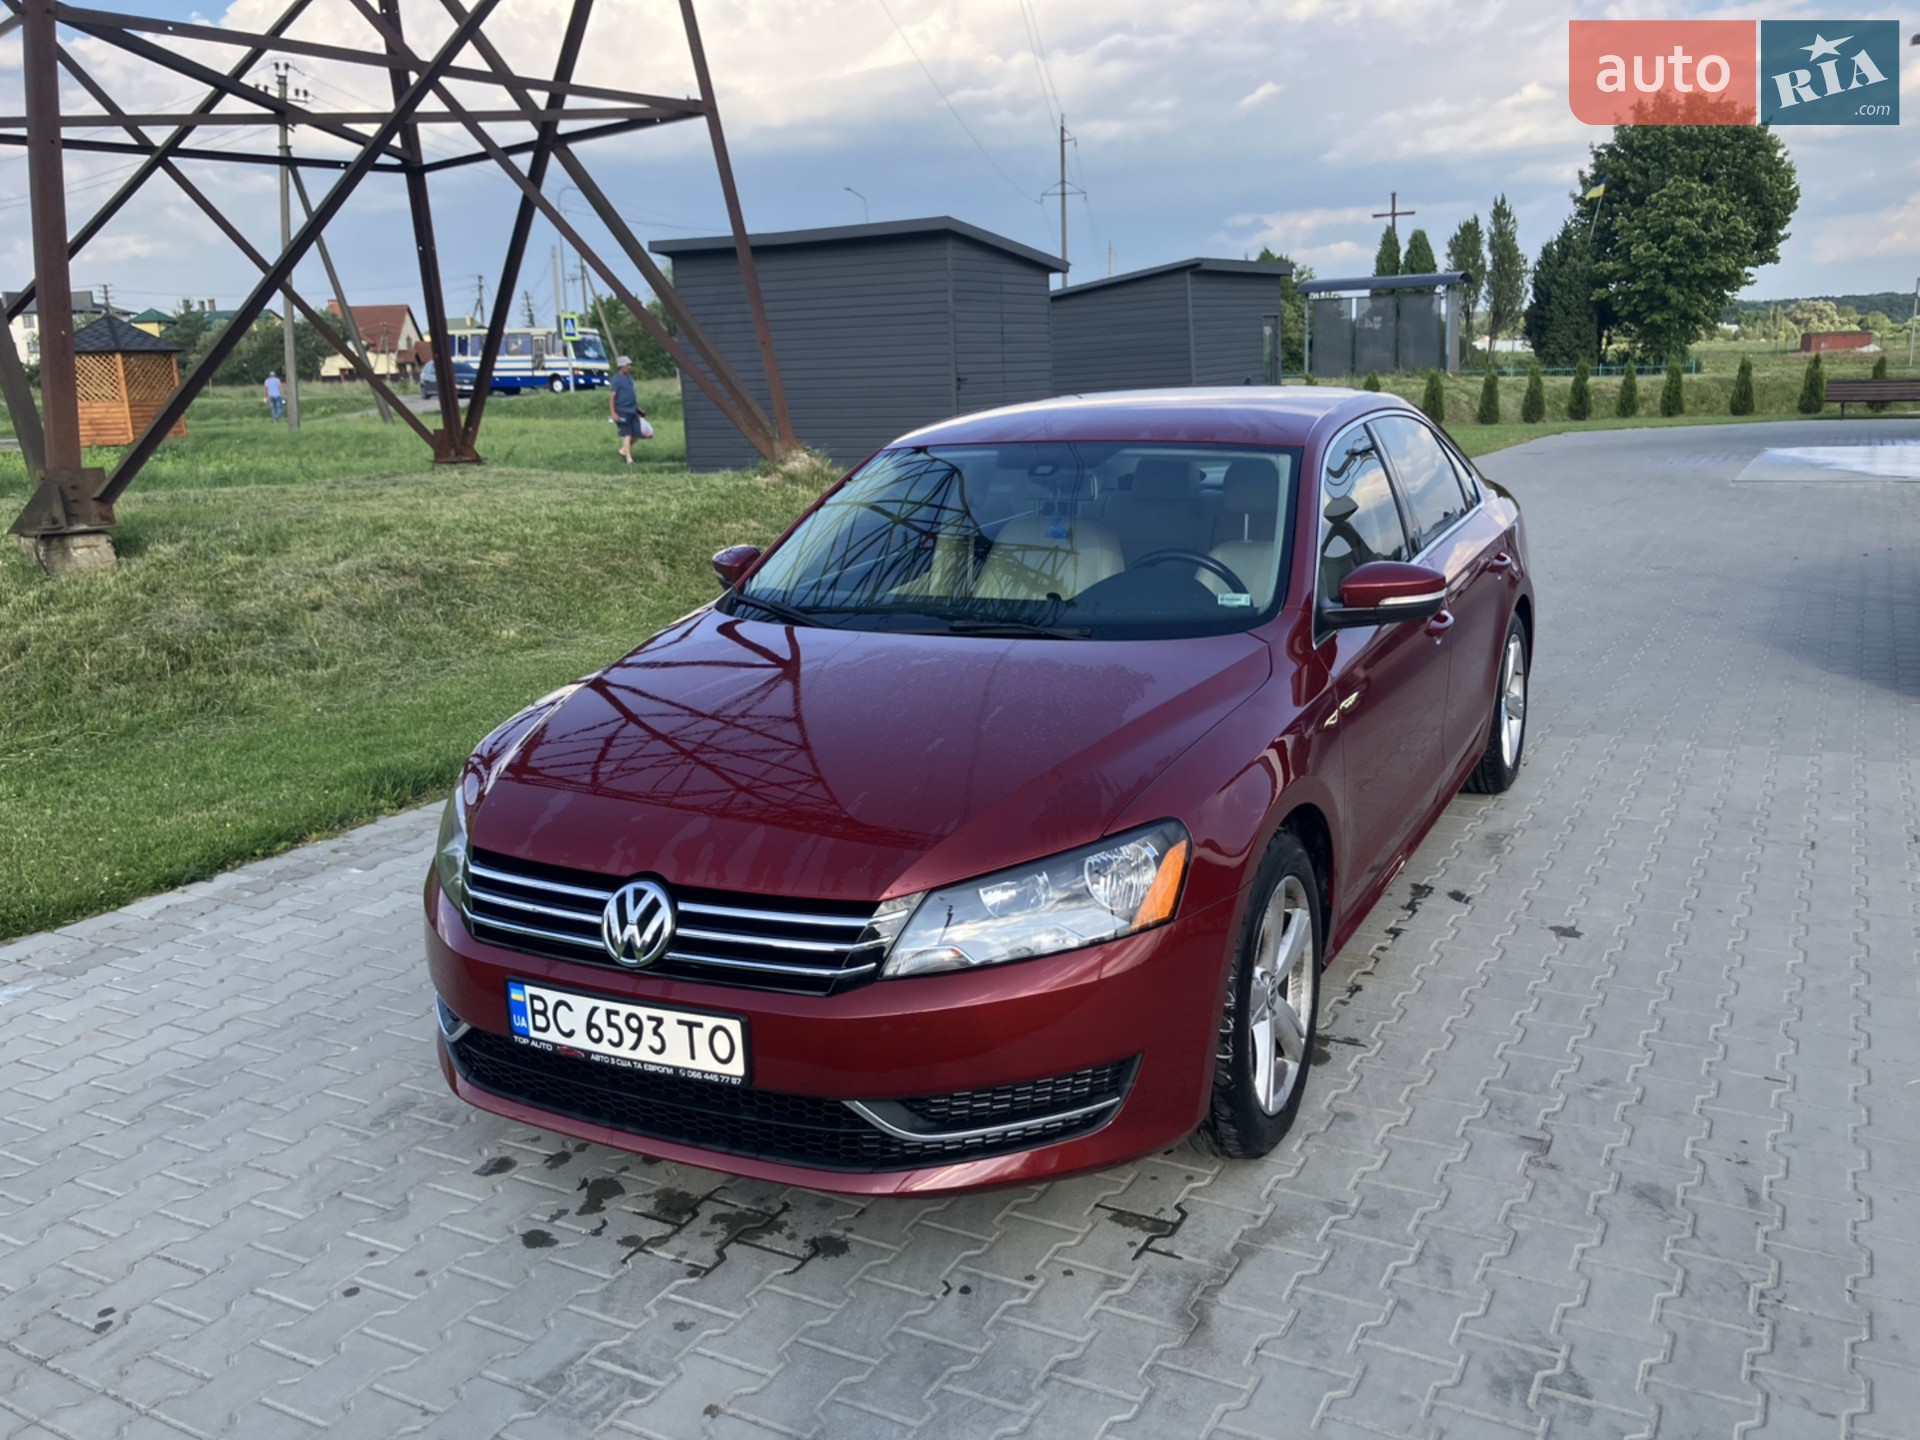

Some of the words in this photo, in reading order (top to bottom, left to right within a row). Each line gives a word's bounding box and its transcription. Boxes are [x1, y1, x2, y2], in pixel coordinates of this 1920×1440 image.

[603, 881, 674, 967] VW
[513, 1015, 527, 1028] UA
[529, 993, 576, 1038] BC
[586, 1006, 667, 1055] 6593
[676, 1019, 736, 1065] TO
[513, 1035, 529, 1045] TOP
[531, 1040, 553, 1051] AUTO
[720, 1075, 730, 1083] 77
